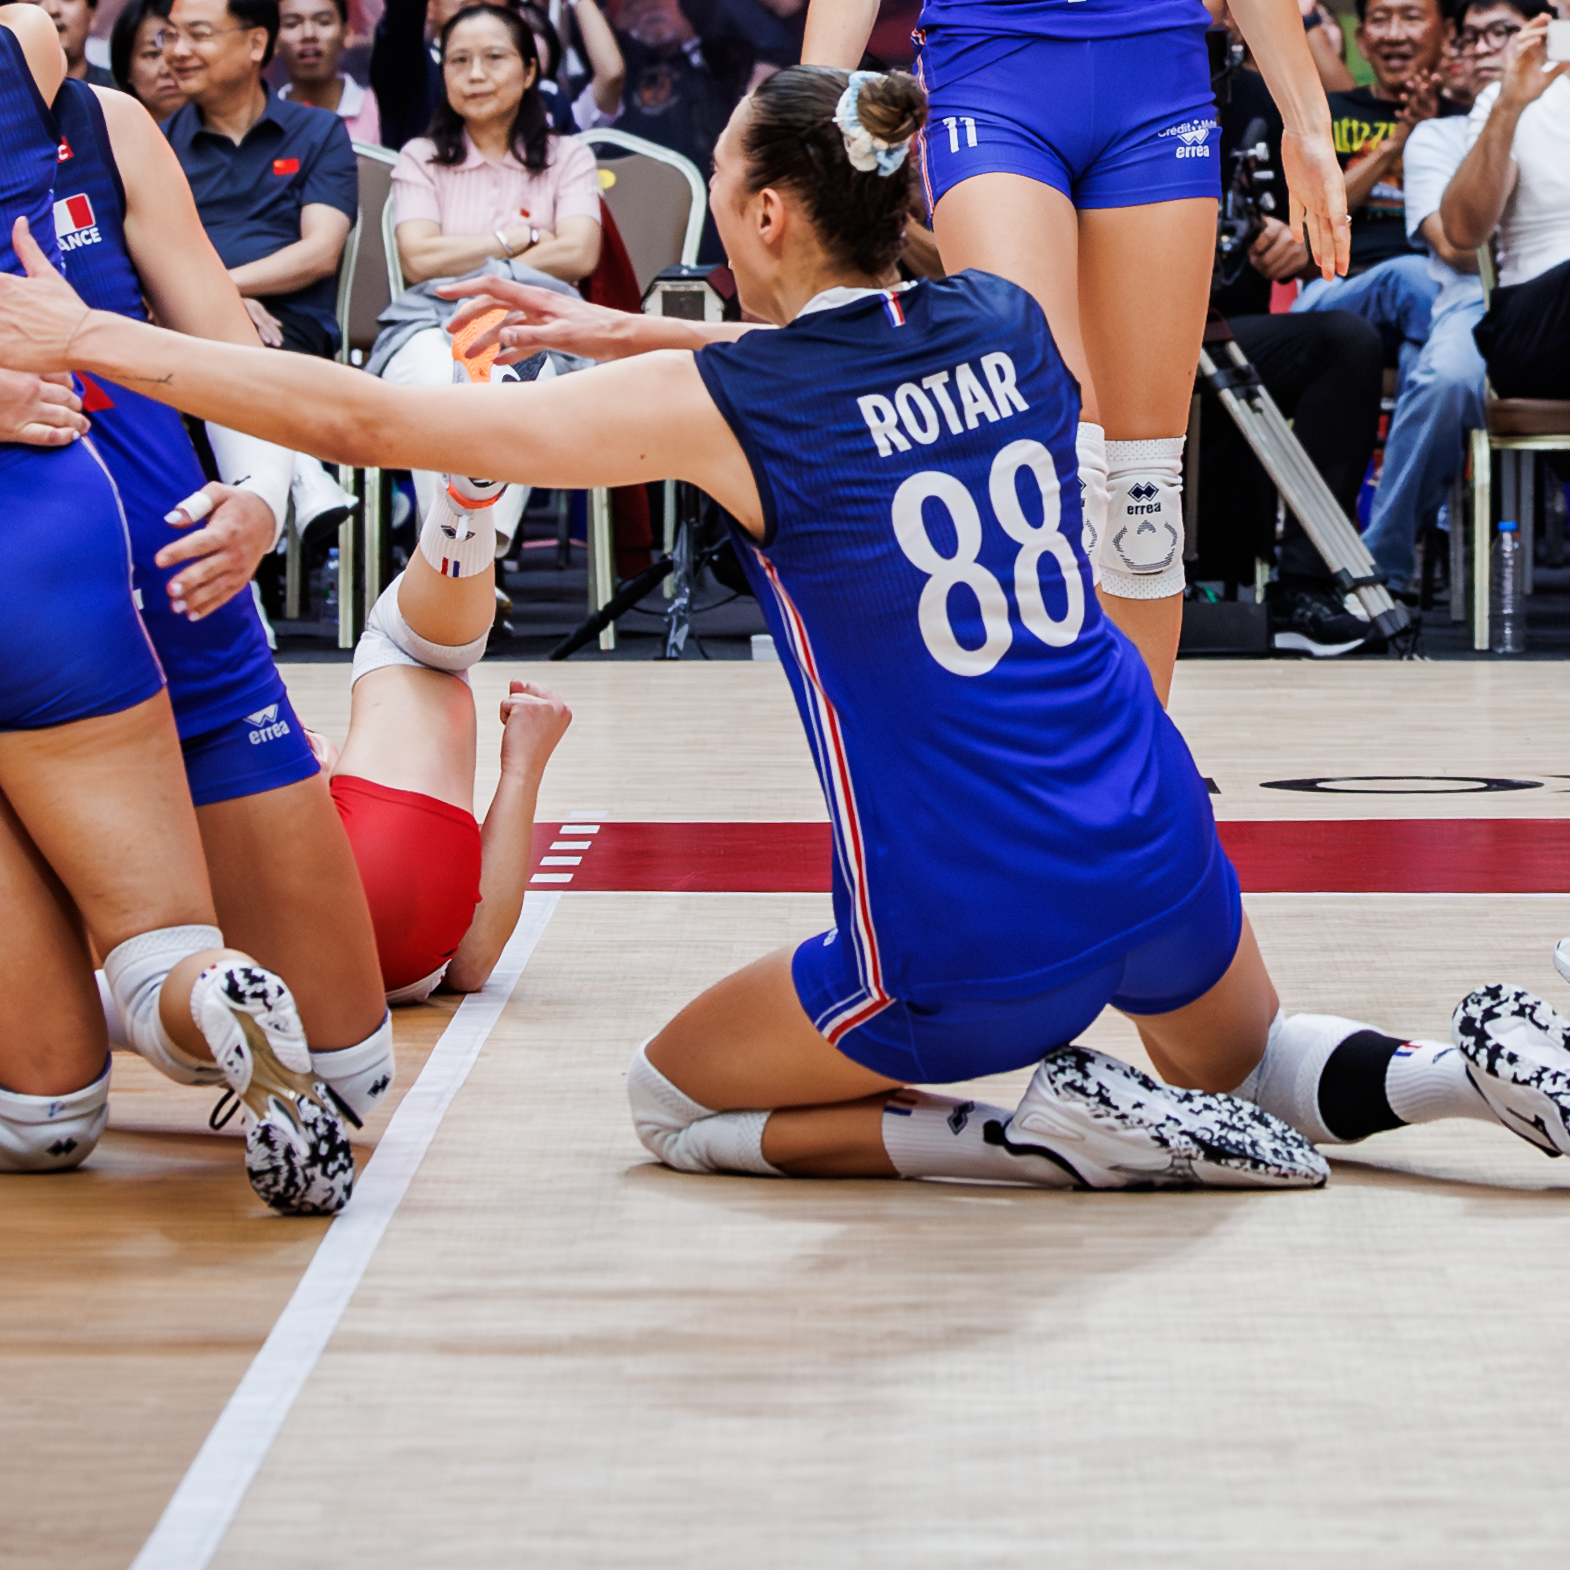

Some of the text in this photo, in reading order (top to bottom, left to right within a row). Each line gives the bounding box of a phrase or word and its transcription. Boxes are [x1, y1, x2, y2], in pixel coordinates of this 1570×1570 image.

[942, 116, 978, 153] 11
[1175, 145, 1210, 159] errea
[57, 227, 103, 252] ANCE
[857, 352, 1030, 457] ROTAR
[1126, 502, 1162, 515] errea
[891, 438, 1086, 678] 88
[248, 720, 291, 745] errea
